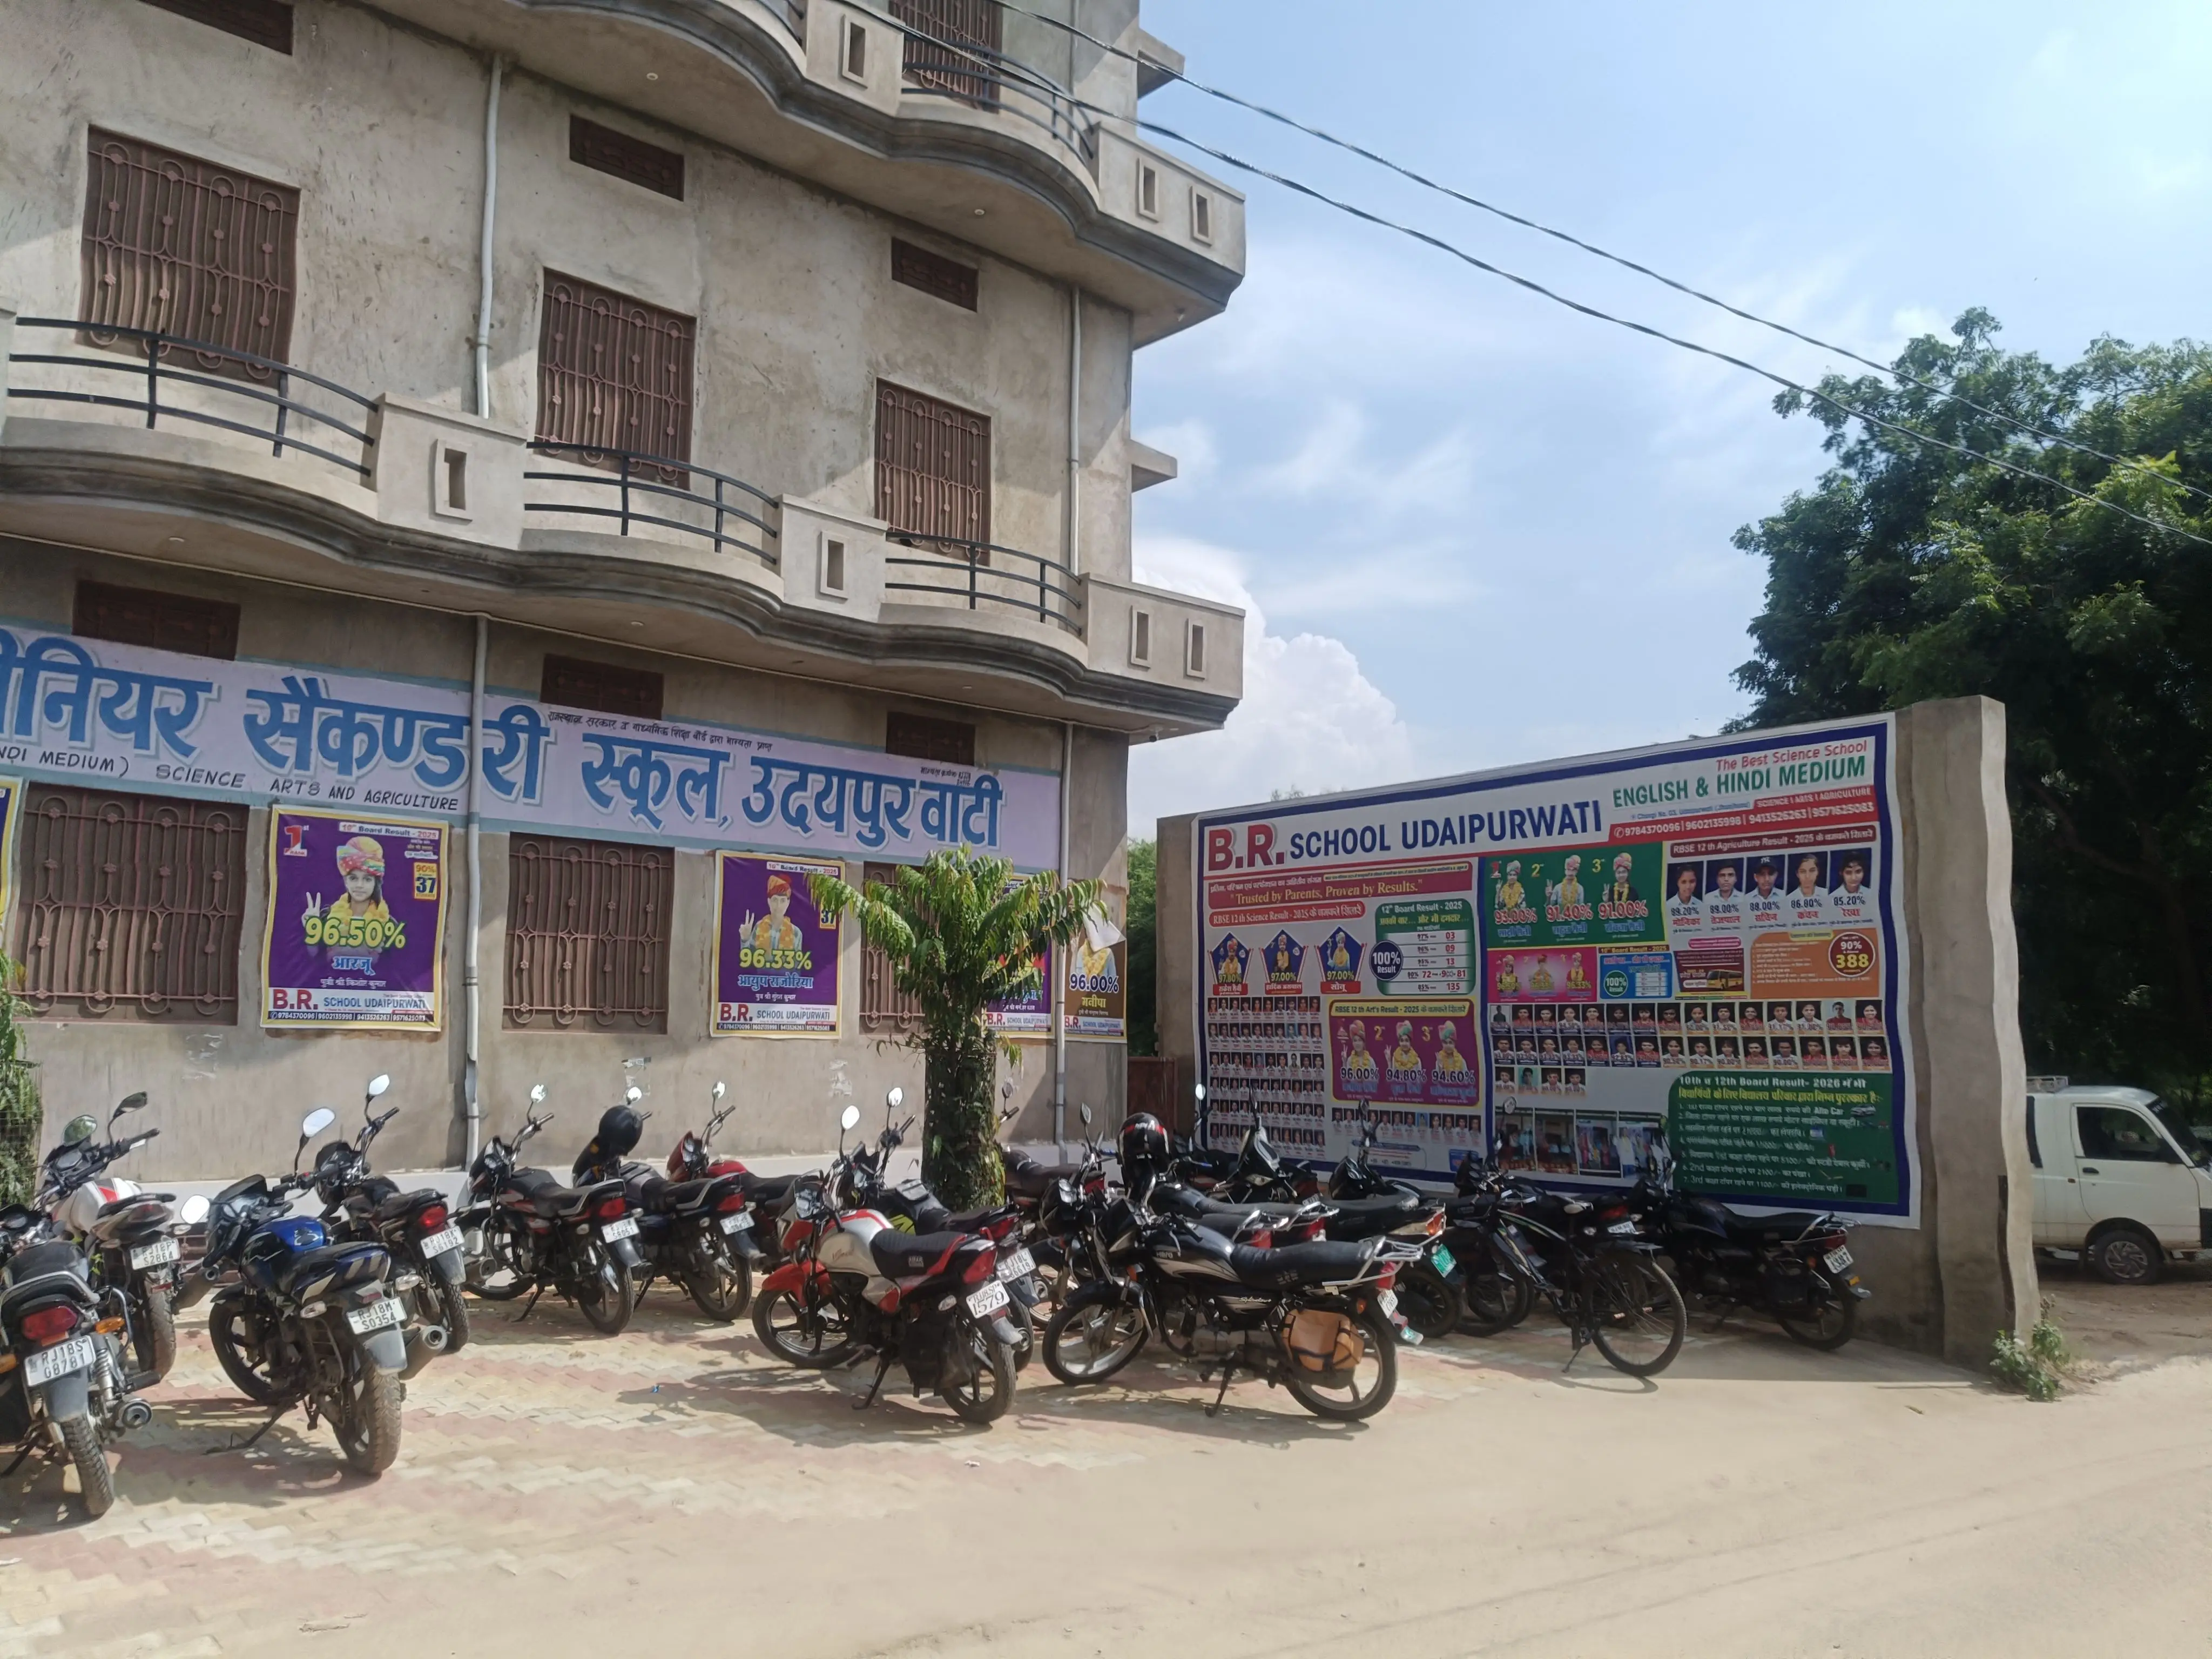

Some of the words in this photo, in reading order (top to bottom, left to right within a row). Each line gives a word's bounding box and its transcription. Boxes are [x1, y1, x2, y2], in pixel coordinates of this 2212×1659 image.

[586, 717, 617, 730] सरकार
[1716, 758, 1737, 772] The
[1742, 754, 1768, 769] Best
[1772, 748, 1820, 765] Science
[1824, 739, 1867, 757] School
[156, 765, 246, 788] SCIENCE
[270, 777, 321, 796] ARTS
[328, 785, 355, 801] AND
[364, 790, 458, 811] AGRICULTURE
[1613, 779, 1688, 808] ENGLISH
[1695, 777, 1709, 798] &
[1717, 766, 1771, 795] HINDI
[1778, 755, 1866, 787] MEDIUM
[359, 825, 382, 833] Board
[385, 827, 410, 836] Result
[1208, 823, 1285, 872] B.R.
[1290, 824, 1391, 859] SCHOOL
[1401, 800, 1603, 850] UDAIPURWATI
[1673, 844, 1695, 854] RBSE
[1717, 838, 1761, 851] Agriculture
[1762, 835, 1789, 846] Result
[416, 876, 436, 894] 37
[1271, 890, 1283, 903] by
[1285, 888, 1323, 901] Parents,
[1326, 885, 1360, 897] Proven
[1363, 883, 1374, 897] by
[1394, 904, 1415, 913] Board
[1417, 903, 1439, 912] Result
[1445, 901, 1462, 910] 2025
[1597, 899, 1649, 919] 91.00%
[1246, 912, 1268, 921] Science
[1269, 911, 1289, 921] Result
[305, 916, 407, 949] 96.50%
[1445, 931, 1455, 940] 03
[1445, 944, 1455, 952] 09
[1840, 941, 1862, 950] 90%
[739, 948, 812, 970] 96.33%
[1372, 952, 1401, 965] 100%
[1446, 957, 1455, 965] 13
[1836, 954, 1869, 968] 388
[332, 955, 376, 977] आरजू
[1377, 965, 1397, 974] Result
[1327, 970, 1355, 981] 97.00%
[1422, 970, 1432, 978] 72
[1457, 969, 1466, 977] 81
[1069, 973, 1120, 993] 96.00%
[1330, 983, 1347, 993] सोनू
[1446, 982, 1460, 990] 135
[1606, 977, 1627, 987] 100%
[273, 989, 319, 1010] B.R.
[323, 997, 361, 1008] SCHOOL
[365, 997, 426, 1009] UDAIPURWATI
[720, 1003, 753, 1022] B.R.
[757, 1010, 784, 1020] SCHOOL
[786, 1010, 830, 1020] UDAIPURWATI
[987, 1013, 1005, 1026] B.R.
[1340, 1067, 1379, 1081] 96.00%
[1386, 1068, 1427, 1082] 94.80%
[1432, 1069, 1476, 1084] 94.60%
[1680, 1076, 1701, 1086] 10th
[1739, 1076, 1769, 1087] Board
[1690, 1175, 1703, 1183] 3rd
[973, 1290, 1004, 1316] 1579
[362, 1313, 396, 1330] S0354
[41, 1339, 84, 1363] RJ18S
